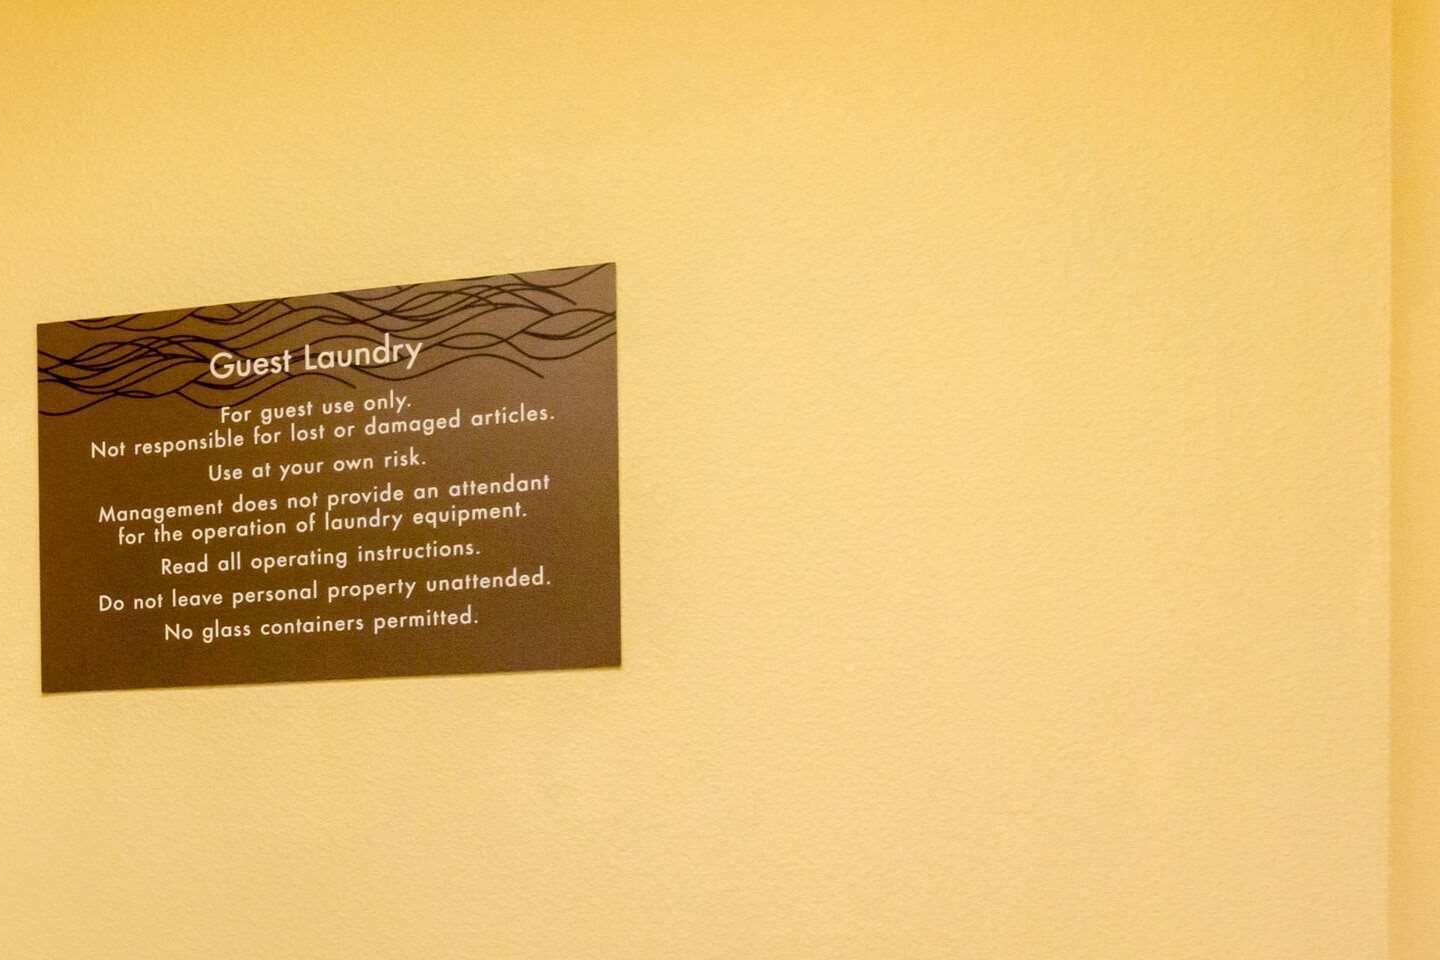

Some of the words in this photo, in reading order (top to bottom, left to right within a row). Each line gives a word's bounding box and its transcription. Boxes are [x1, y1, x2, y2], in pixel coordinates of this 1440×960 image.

[209, 349, 293, 380] Guest
[304, 332, 423, 371] Laundry
[220, 406, 252, 424] For
[260, 401, 313, 424] guest
[322, 400, 354, 415] use
[363, 389, 411, 412] only.
[91, 440, 126, 459] Not
[134, 428, 244, 458] responsible
[253, 425, 281, 445] for
[290, 422, 325, 442] lost
[333, 425, 355, 438] or
[364, 408, 461, 436] damaged
[471, 402, 555, 426] articles.
[208, 464, 243, 482] Use
[251, 462, 272, 479] at
[279, 461, 324, 482] your
[333, 457, 374, 472] own
[384, 446, 426, 468] risk.
[98, 499, 224, 524] Management
[231, 493, 278, 513] does
[287, 492, 318, 509] not
[327, 482, 404, 511] provide
[413, 486, 438, 500] an
[448, 473, 550, 497] attendant
[118, 526, 146, 546] for
[154, 523, 183, 543] the
[191, 519, 287, 545] operation
[295, 512, 316, 533] of
[325, 508, 403, 531] laundry
[412, 502, 527, 529] equipment.
[161, 553, 209, 576] Read
[217, 551, 241, 572] all
[250, 548, 348, 574] operating
[358, 540, 481, 562] instructions.
[98, 594, 125, 612] Do
[133, 593, 164, 610] not
[172, 588, 223, 608] leave
[232, 580, 318, 609] personal
[327, 578, 417, 603] property
[426, 566, 551, 593] unattended.
[164, 623, 193, 641] No
[202, 619, 252, 644] glass
[260, 615, 364, 636] containers
[373, 605, 478, 635] permitted.
